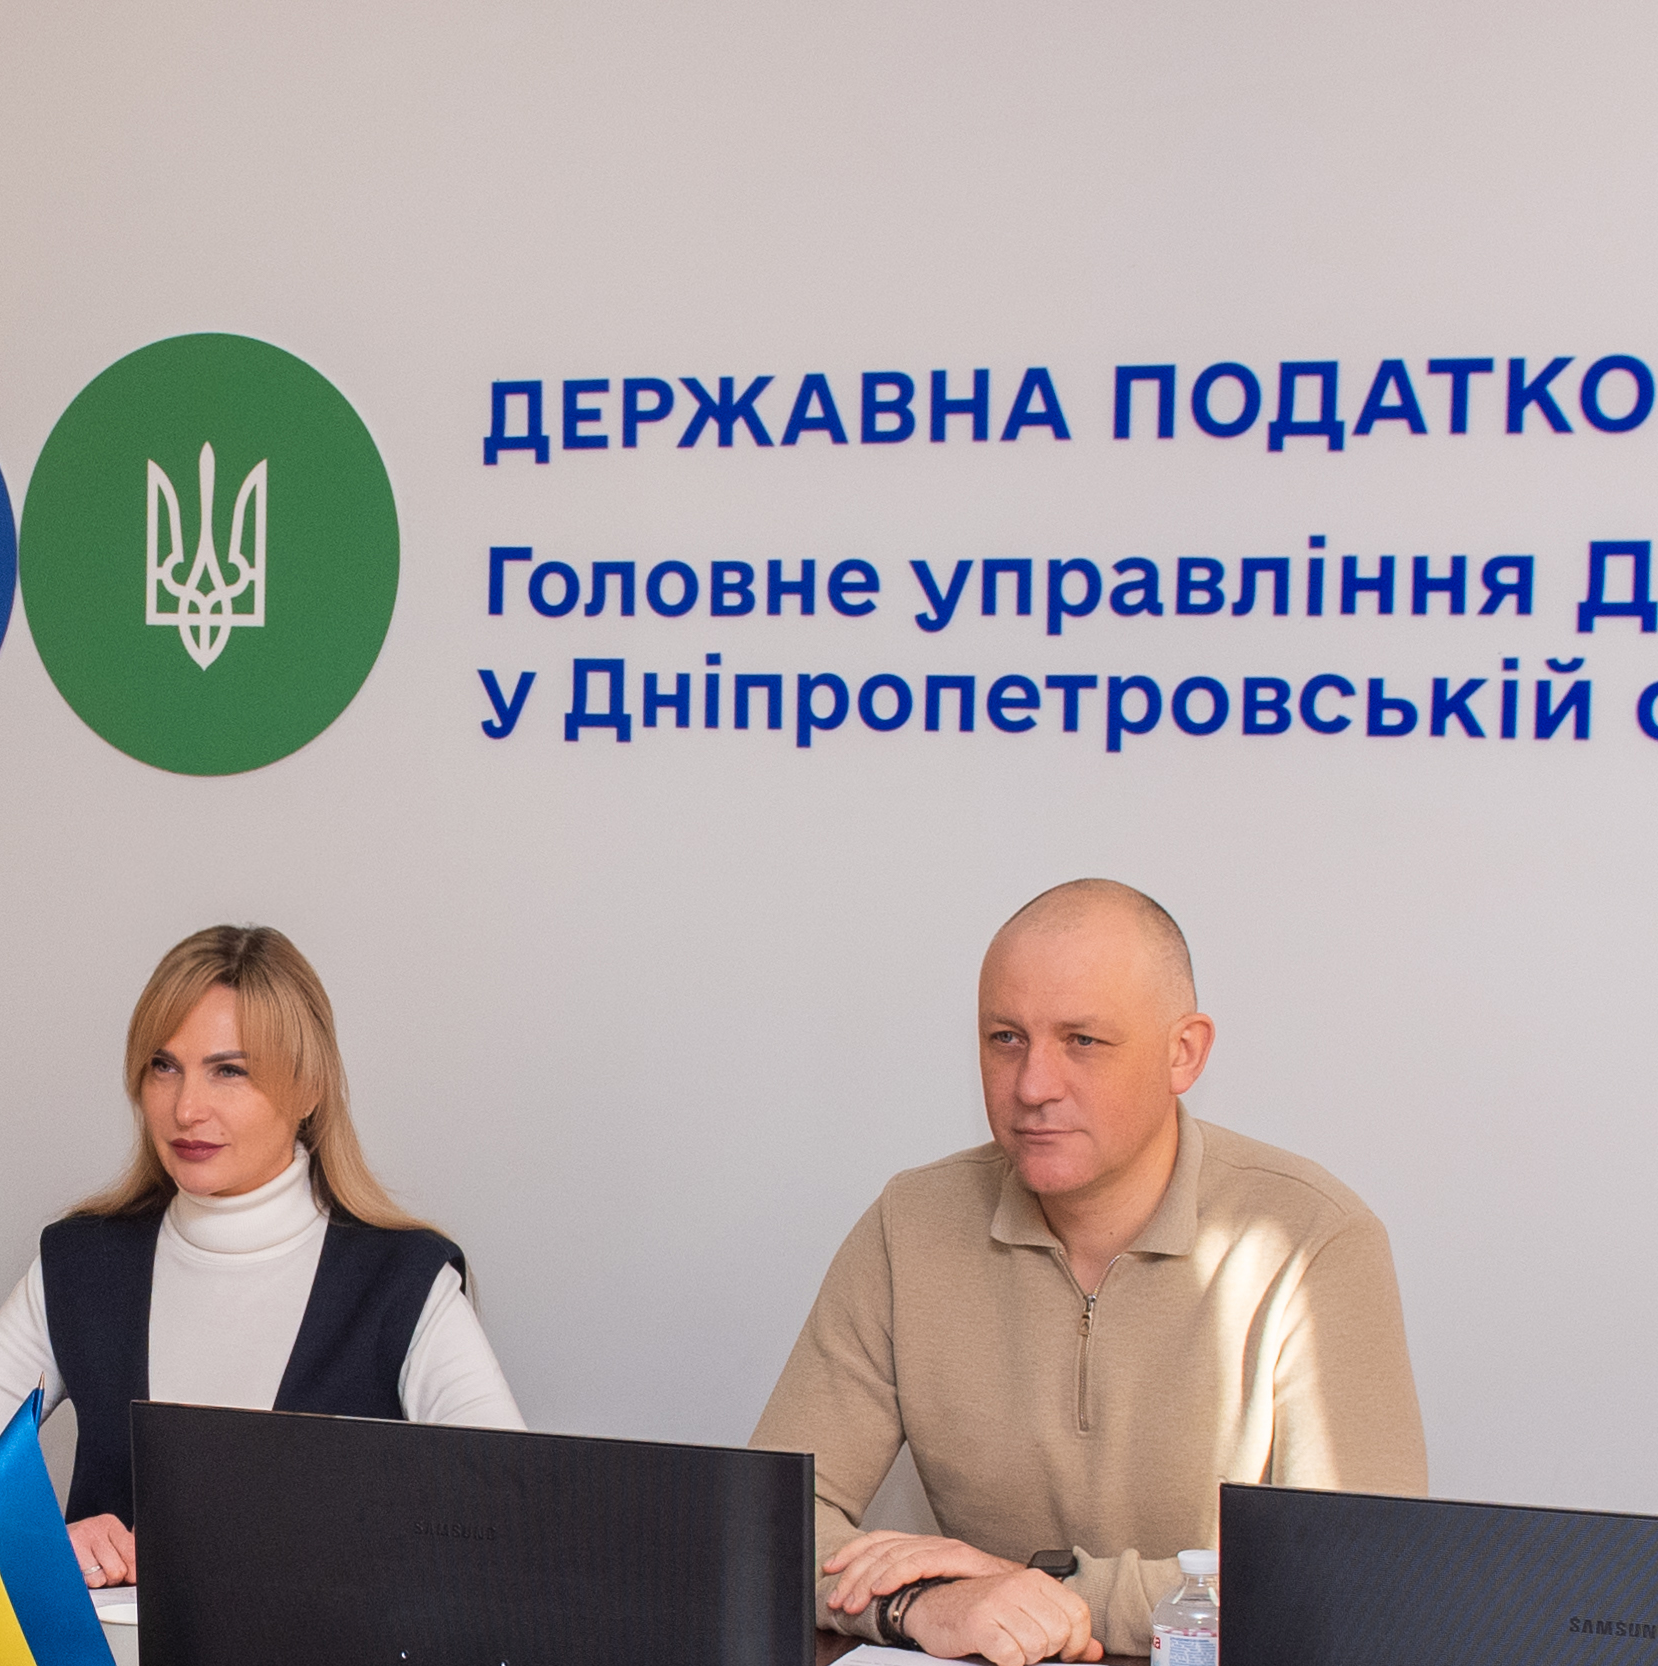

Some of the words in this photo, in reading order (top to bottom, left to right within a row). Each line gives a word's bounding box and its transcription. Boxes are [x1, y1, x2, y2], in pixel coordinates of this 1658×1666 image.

[483, 365, 1072, 464] ДЕРЖАВНА
[488, 545, 881, 617] Головне
[910, 533, 1536, 635] управління
[478, 668, 536, 738] у
[564, 651, 1593, 751] Дніпропетровській
